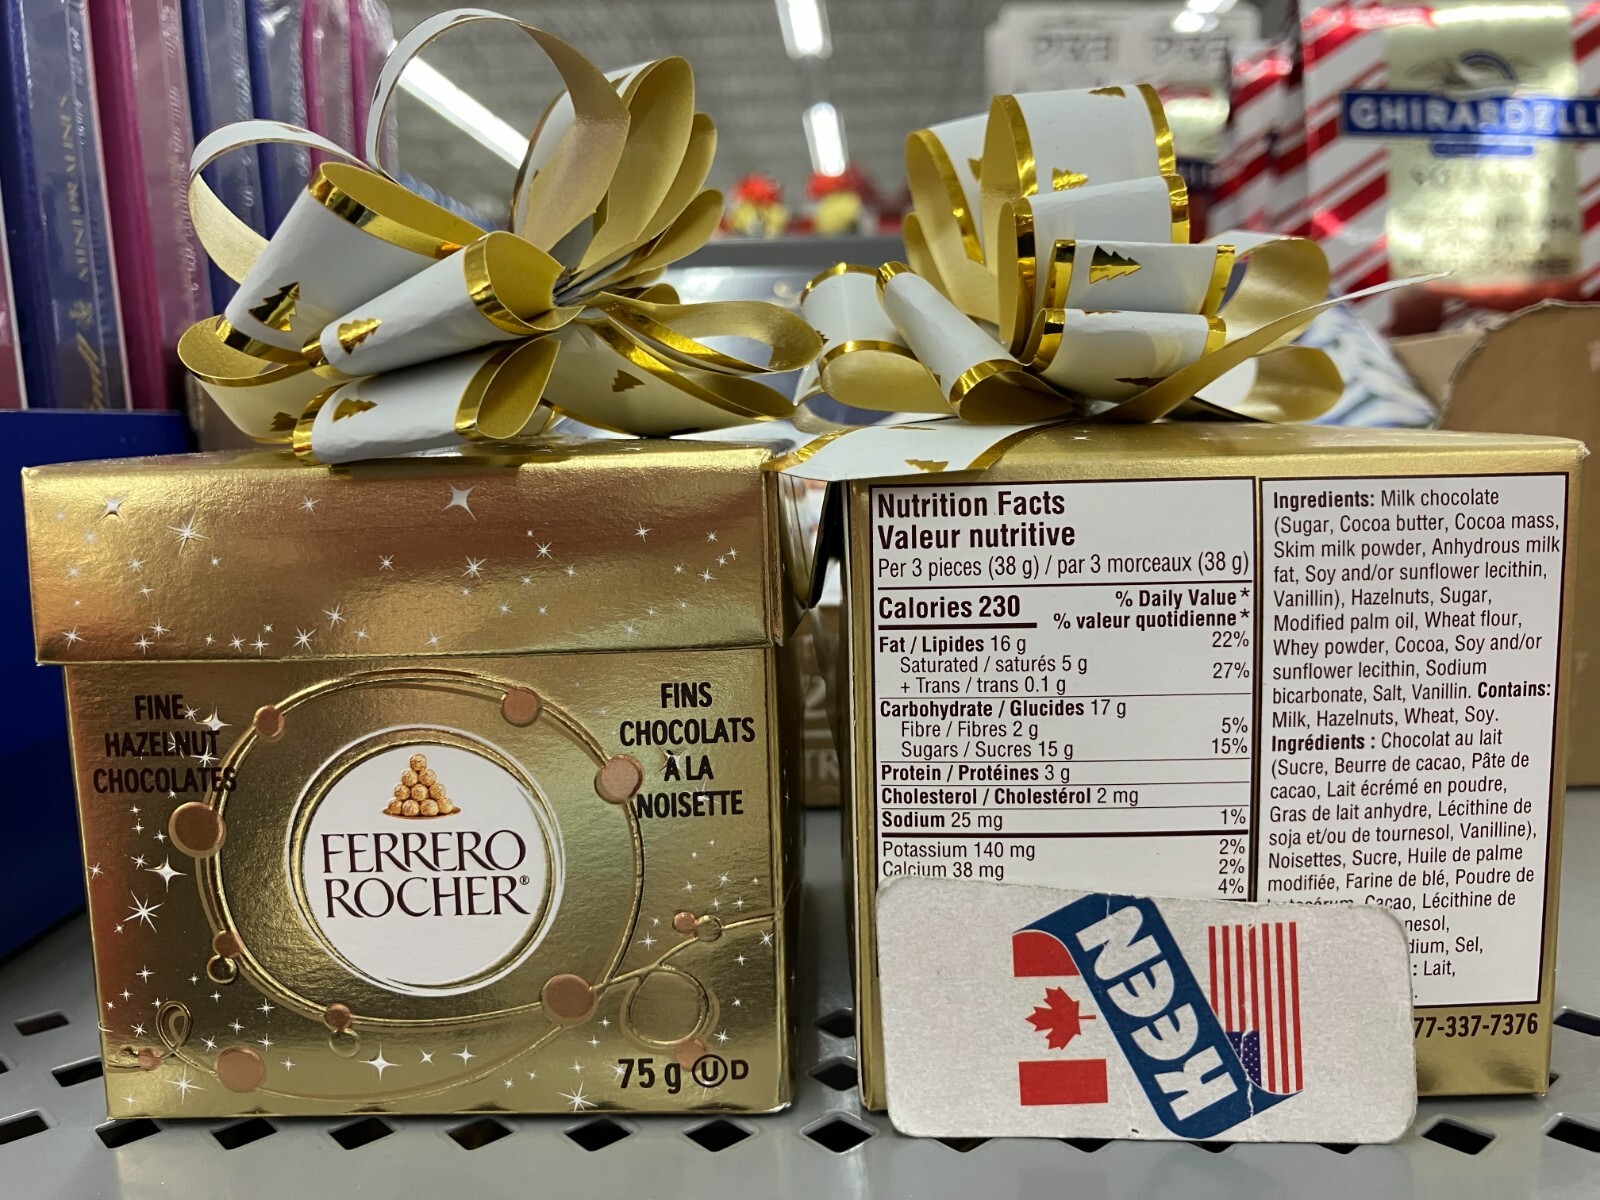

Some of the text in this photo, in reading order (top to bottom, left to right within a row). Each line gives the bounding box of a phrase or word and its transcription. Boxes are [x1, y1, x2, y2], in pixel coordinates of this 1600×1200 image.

[877, 490, 1065, 518] Nutrition Facts
[1274, 488, 1499, 512] Ingredients: Milk chocolate
[1274, 512, 1559, 537] (Sugar, Cocoa butter, Cocoa mass,
[877, 522, 1075, 550] Valeur nutritive
[1274, 535, 1560, 559] Skim milk powder, Anhydrous milk
[878, 550, 1249, 580] Per 3 pieces (38 g) par 3 morceaux (38 g)
[1273, 560, 1547, 585] fat, Soy and/or sunflower lecithin,
[879, 594, 1020, 620] Calories 230
[1139, 589, 1183, 608] Daily
[1273, 586, 1492, 609] Vanillin), Hazelnuts, Sugar,
[1076, 612, 1131, 629] valeur
[1274, 610, 1522, 632] Modified palm oil, Wheat flour,
[879, 634, 1026, 656] Fat Lipides 16 g
[1212, 630, 1249, 648] 22%
[1273, 633, 1542, 658] Whey powder, Cocoa, Soy and/or
[900, 654, 1087, 675] Saturated saturés 5 g
[1212, 662, 1250, 679] 27%
[1273, 658, 1487, 680] sunflower lecithin, Sodium
[660, 682, 713, 708] FINS
[915, 675, 1066, 696] Trans trans 0.1 g
[1272, 681, 1551, 704] bicarbonate, Salt, Vanillin. Contains:
[134, 694, 185, 720] FINE
[880, 699, 1126, 720] Carbohydrate Glucides 17 g
[1272, 706, 1498, 730] Milk, Hazelnuts, Wheat, Soy.
[619, 717, 756, 746] CHOCOLATS
[901, 720, 1038, 741] Fibre Fibres 2 g
[1221, 716, 1248, 734] 5%
[105, 730, 220, 757] HAZELNUT
[901, 740, 1073, 760] Sugars Sucres 15 g
[1212, 737, 1248, 754] 15%
[1272, 728, 1503, 755] Ingrédients Chocolat au lait
[664, 750, 714, 781] À LA
[881, 764, 1070, 784] Protein Protéines 3 g
[1271, 751, 1529, 779] (Sucre, Beurre de cacao, Pâte de
[93, 766, 237, 793] CHOCOLATES
[636, 790, 744, 818] NOISETTE
[882, 785, 1138, 807] Cholesterol Cholestérol 2 mg
[882, 810, 1003, 832] Sodium 25 mg
[1220, 808, 1246, 825] 1%
[321, 829, 526, 873] FERRERO
[883, 841, 1035, 862] Potassium 140 mg
[1219, 838, 1246, 855] 2%
[882, 861, 1004, 882] Calcium 38 mg
[1218, 858, 1245, 875] 2%
[1218, 878, 1244, 894] 4%
[1268, 867, 1534, 892] modifiée, Farine de blé, Poudre de
[1422, 891, 1492, 909] Lécithine
[1497, 890, 1516, 906] de
[1404, 915, 1449, 933] nesol,
[1455, 936, 1483, 954] Sel,
[1423, 960, 1456, 977] Lait,
[1075, 905, 1239, 1121] KEEN
[1414, 1013, 1538, 1038] 77-337-7376
[618, 1058, 682, 1094] 75 g
